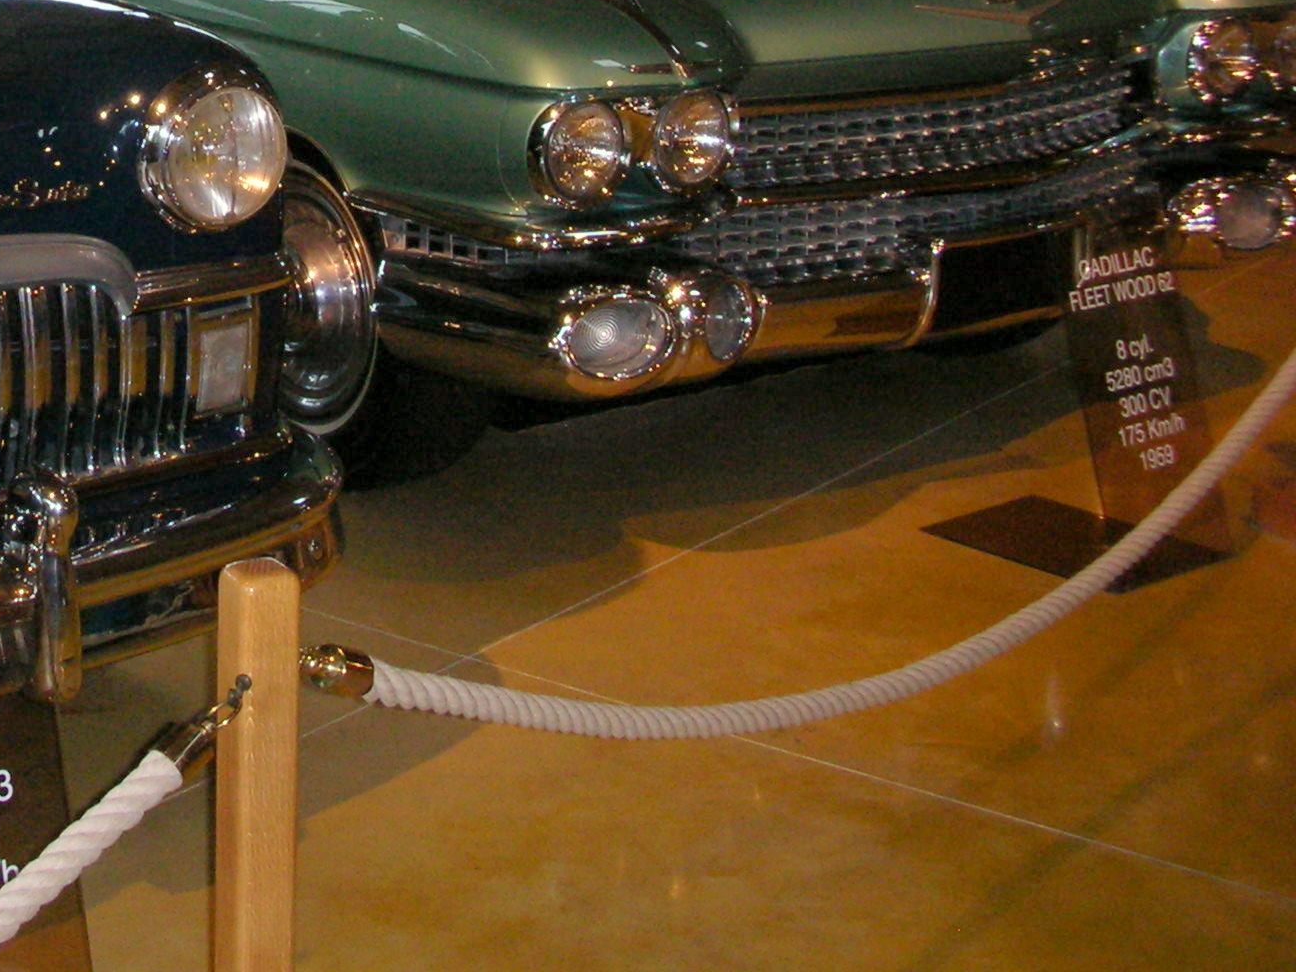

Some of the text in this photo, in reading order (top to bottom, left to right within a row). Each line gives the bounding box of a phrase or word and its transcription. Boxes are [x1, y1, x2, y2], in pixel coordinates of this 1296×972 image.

[1079, 246, 1154, 281] CADILLAC
[1116, 339, 1127, 360] 8
[1144, 357, 1174, 382] cm3
[1120, 386, 1170, 418] 300 CV
[1118, 422, 1145, 446] 175
